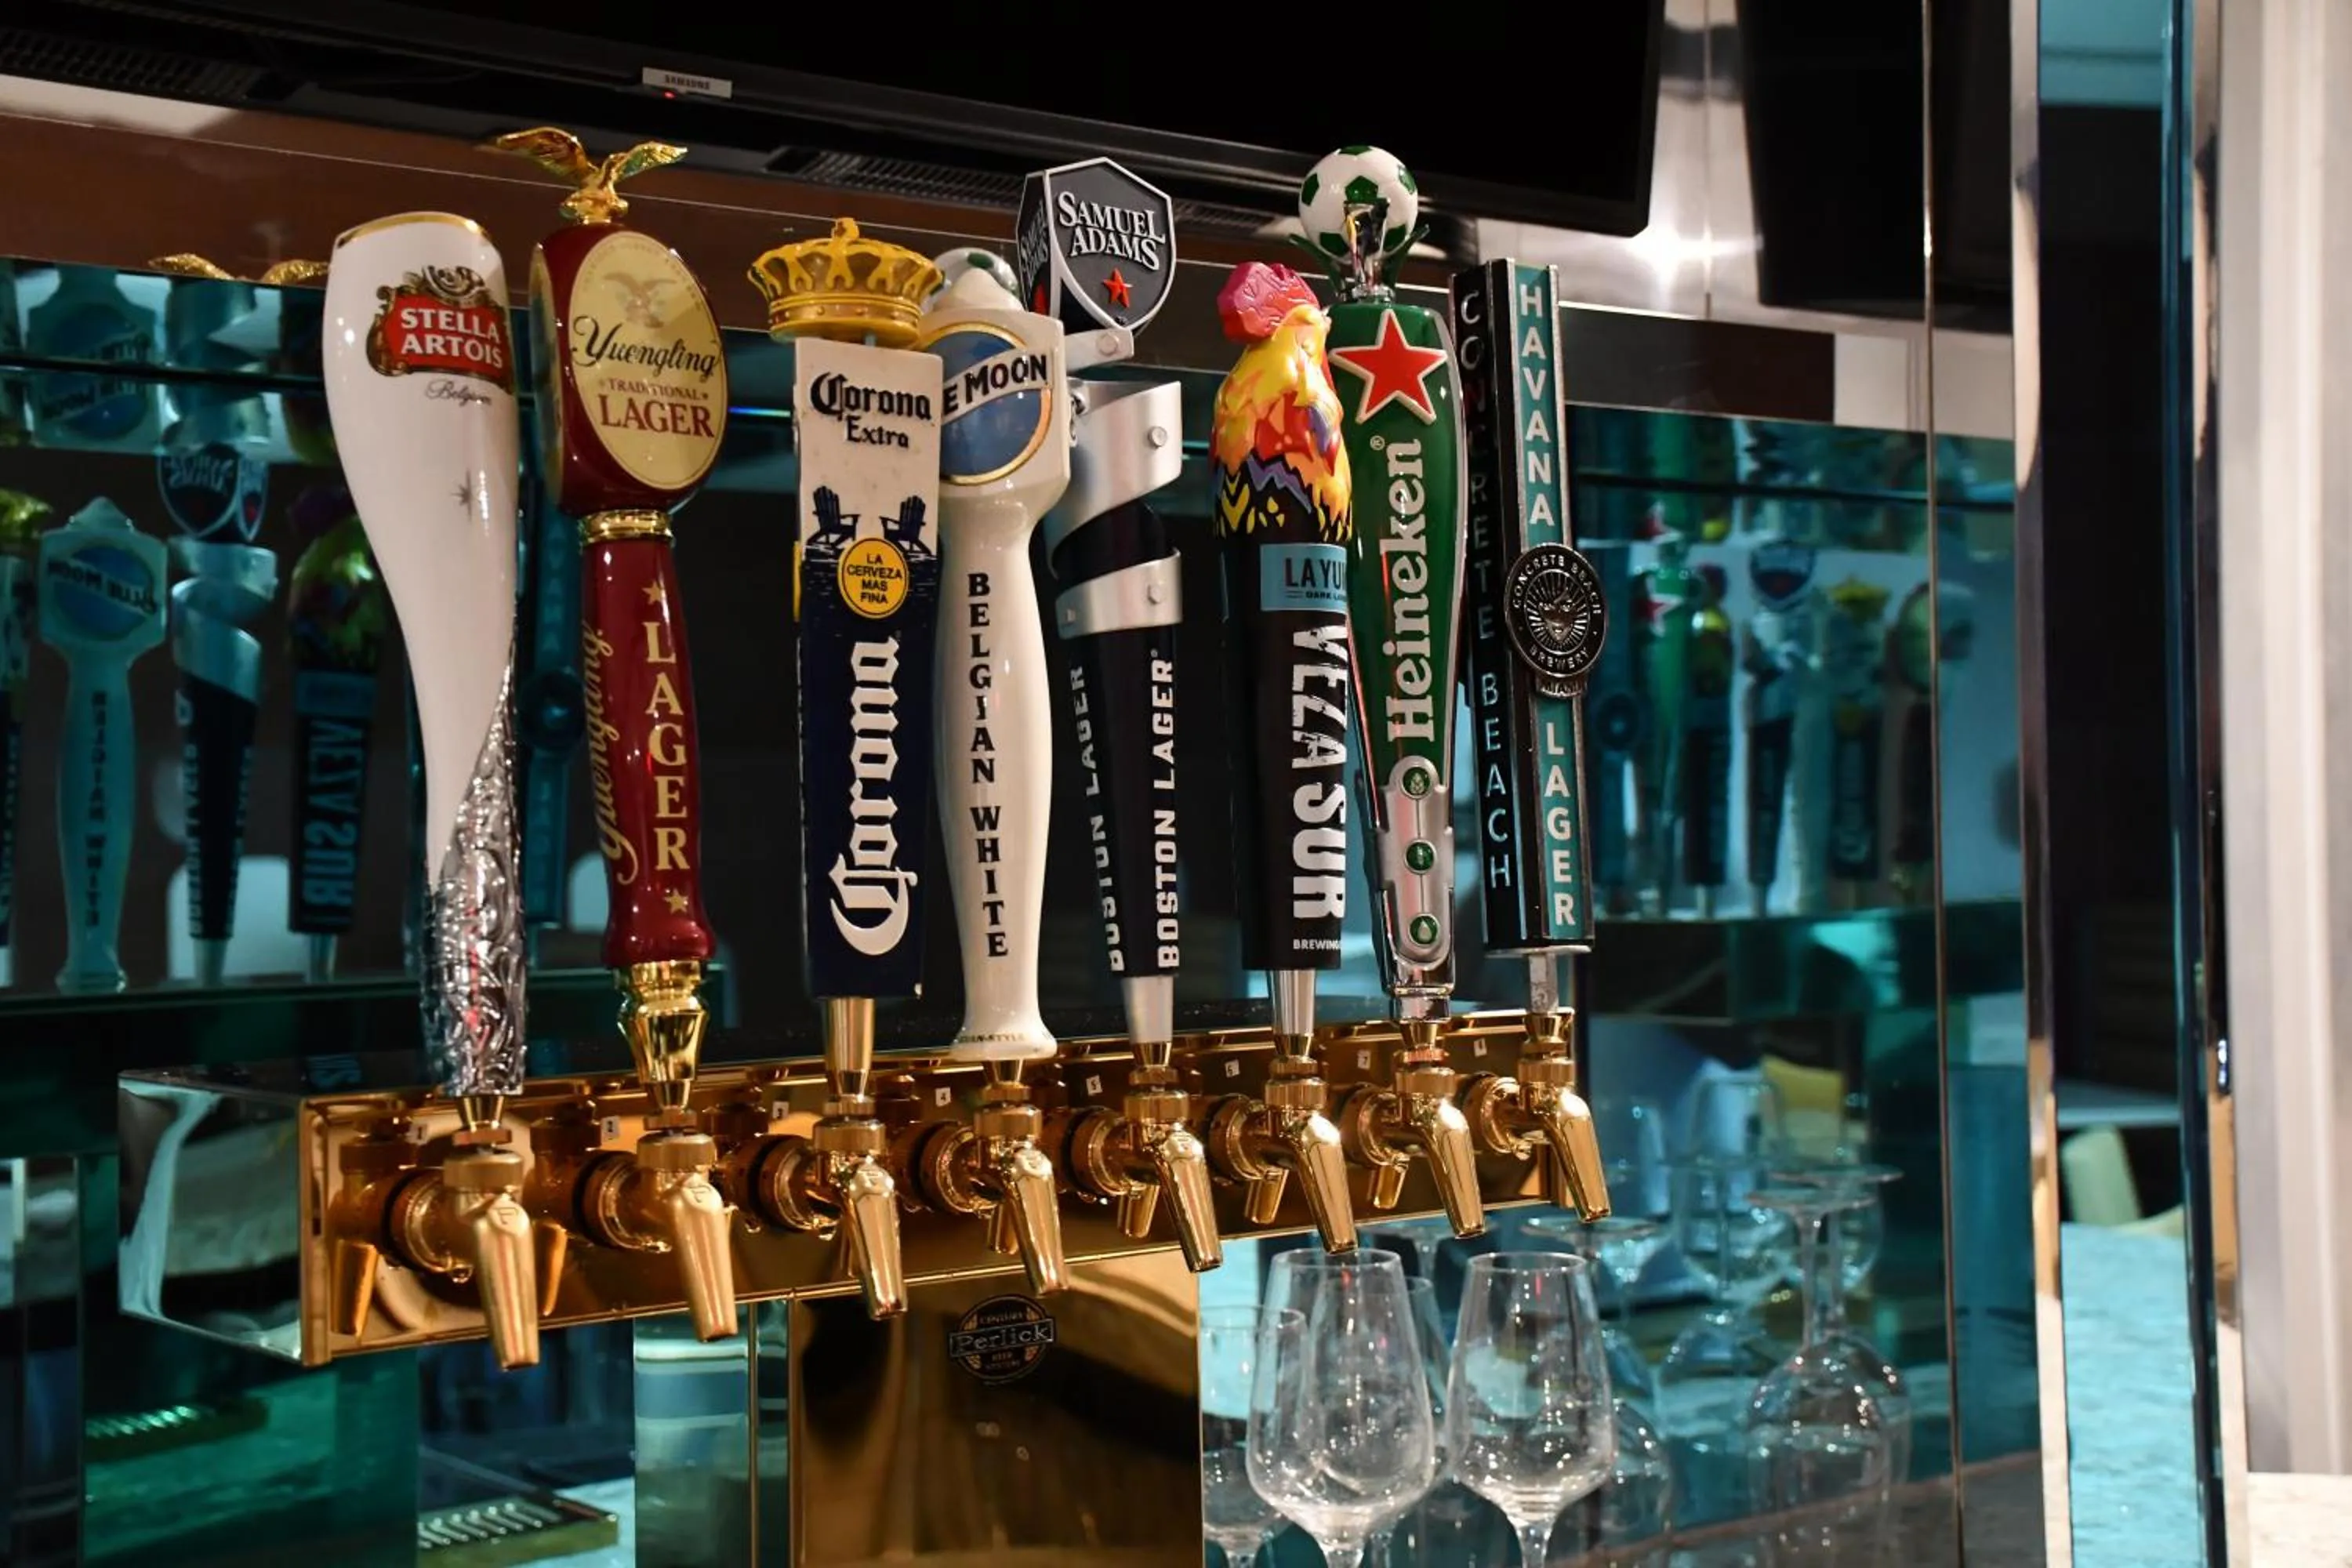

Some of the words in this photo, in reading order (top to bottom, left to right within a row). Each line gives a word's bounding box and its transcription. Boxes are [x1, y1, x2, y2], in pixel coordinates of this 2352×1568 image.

[1058, 191, 1166, 245] SAMUEL
[1069, 226, 1160, 271] ADAMS
[400, 307, 500, 345] STELLA
[400, 332, 503, 369] ARTOIS
[572, 315, 720, 383] Yuengling
[810, 372, 932, 422] Corona
[966, 354, 1049, 403] MOON
[1519, 284, 1555, 527] HAVANA
[597, 394, 715, 438] LAGER
[846, 414, 909, 448] Extra
[847, 564, 902, 581] CERVEZA
[862, 579, 887, 592] MAS
[866, 554, 884, 566] LA
[1380, 437, 1436, 743] Heineken
[860, 591, 887, 604] FINA
[967, 572, 995, 784] BELGIAN
[1291, 625, 1348, 769] VEZA
[641, 622, 690, 871] LAGER
[1151, 659, 1174, 790] LAGER
[828, 635, 918, 956] Corona
[1481, 673, 1512, 889] BEACH
[1292, 782, 1347, 919] SUR
[1543, 722, 1575, 927] LAGER
[970, 806, 1008, 957] WHITE
[1153, 810, 1180, 968] BOSTON
